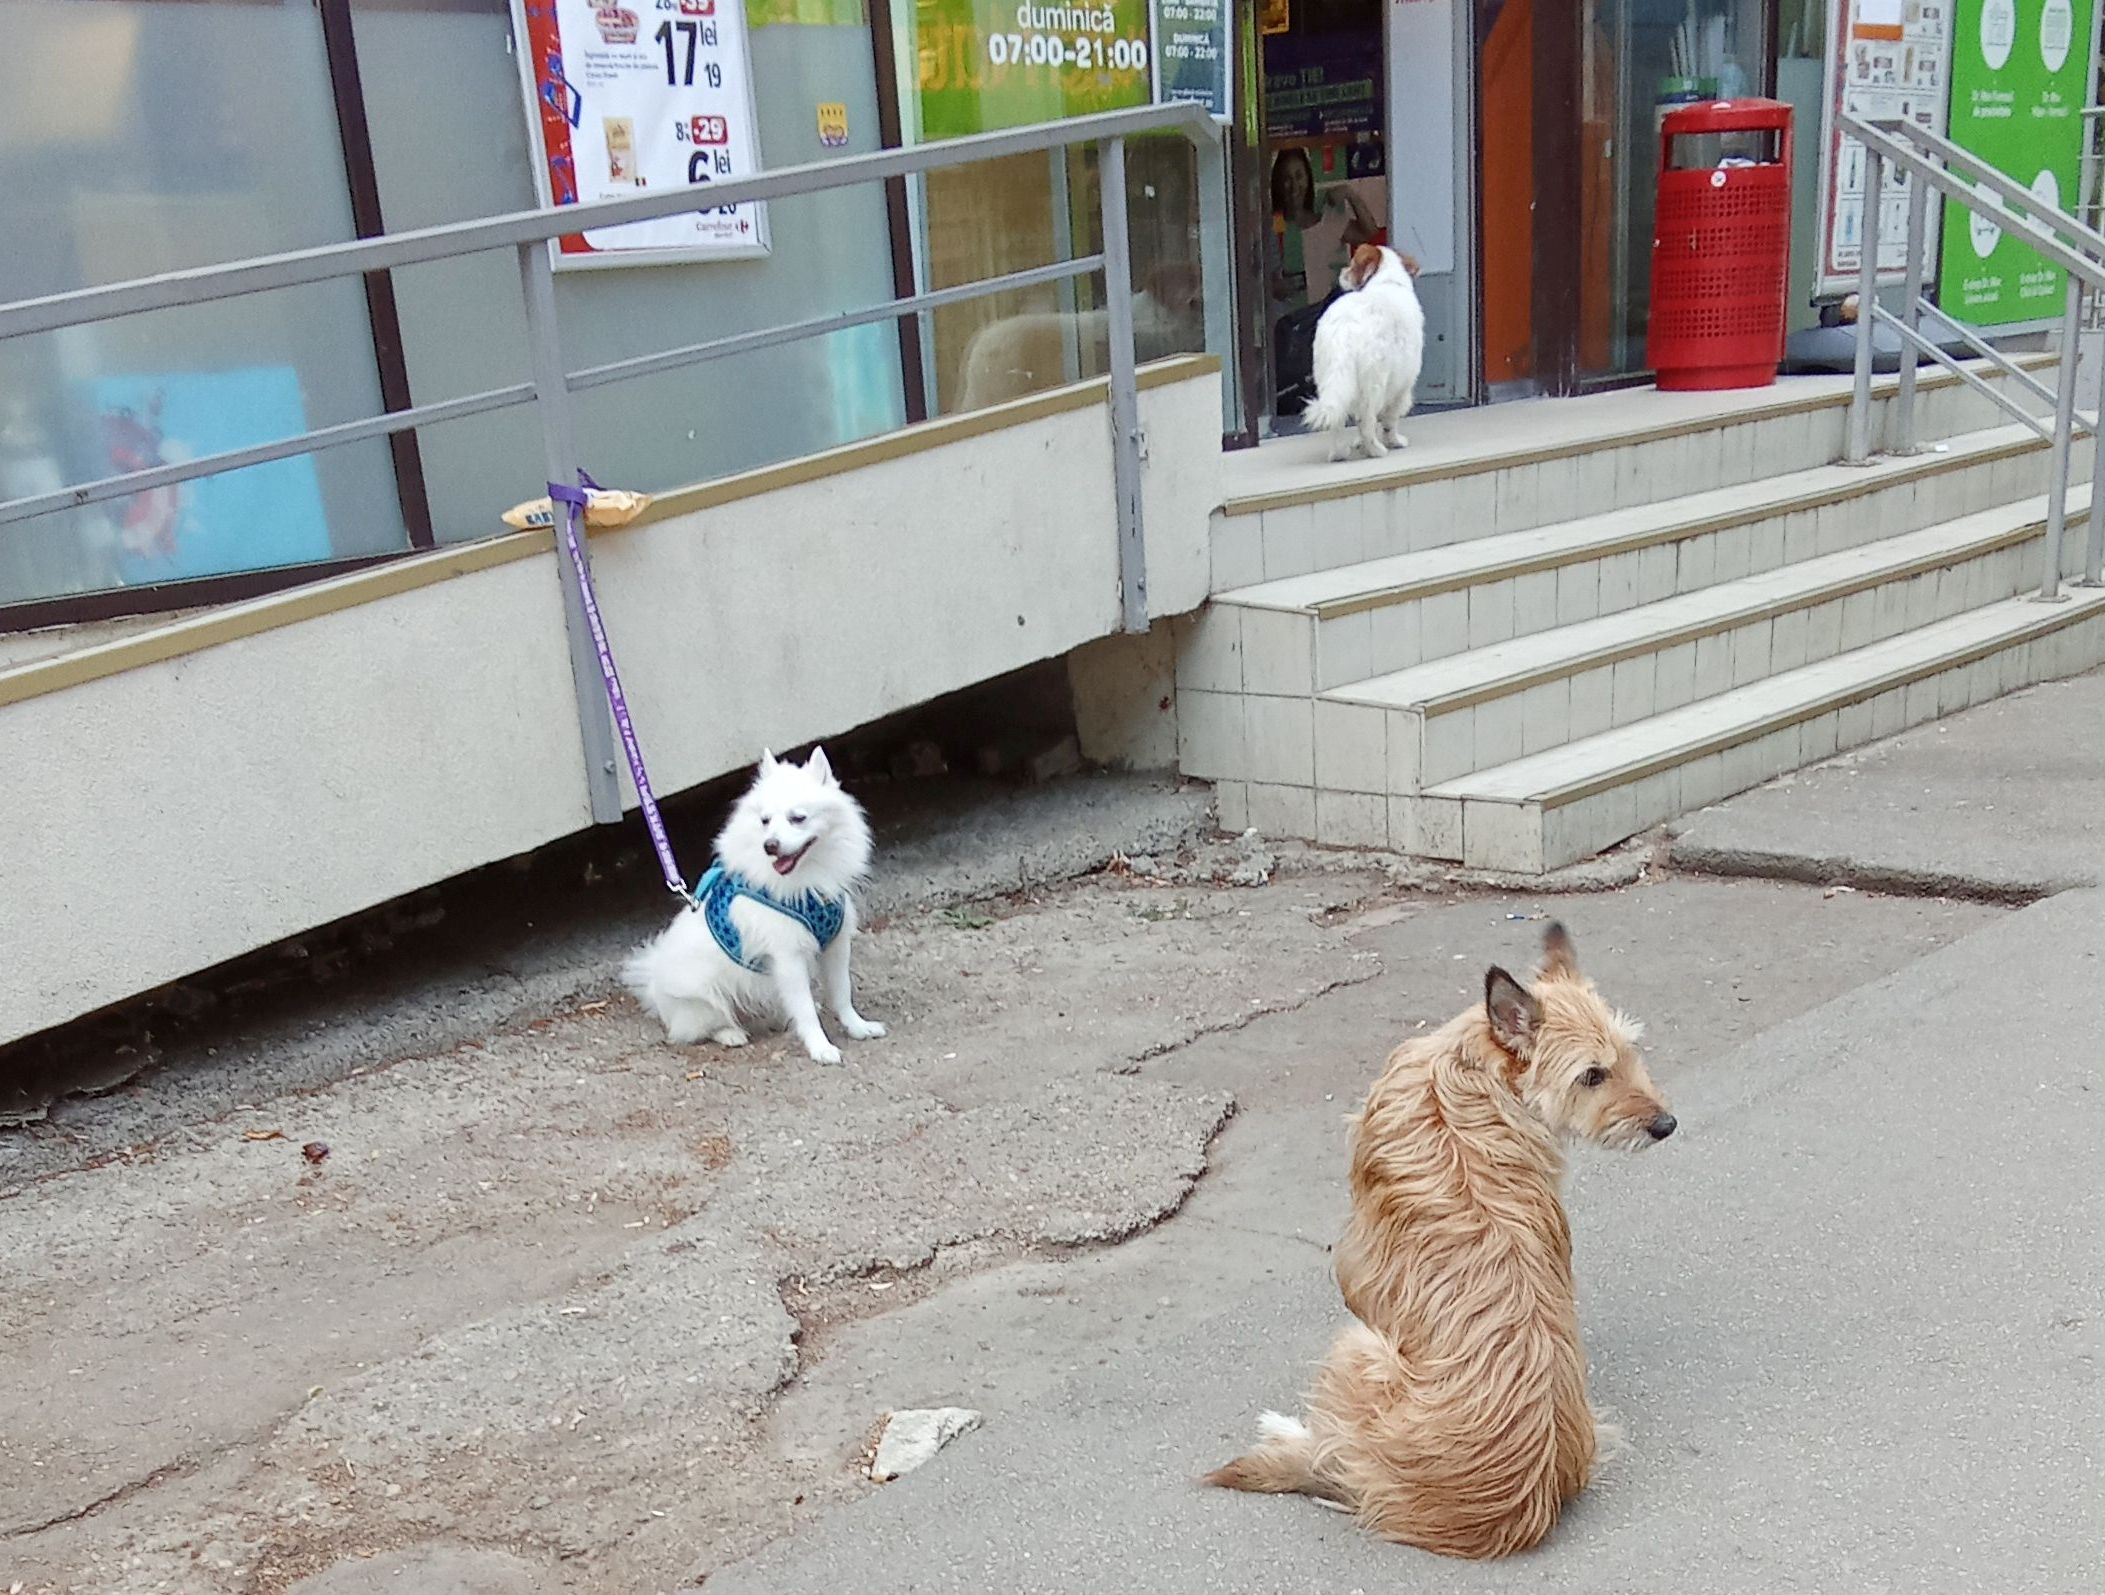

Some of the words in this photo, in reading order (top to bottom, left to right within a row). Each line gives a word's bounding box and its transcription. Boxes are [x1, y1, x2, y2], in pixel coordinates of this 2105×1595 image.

[1017, 1, 1115, 33] duminică
[655, 21, 697, 85] 17
[700, 20, 718, 46] lei
[988, 33, 1147, 70] 07:00-21:00
[704, 63, 721, 88] 19
[714, 149, 732, 174] lei
